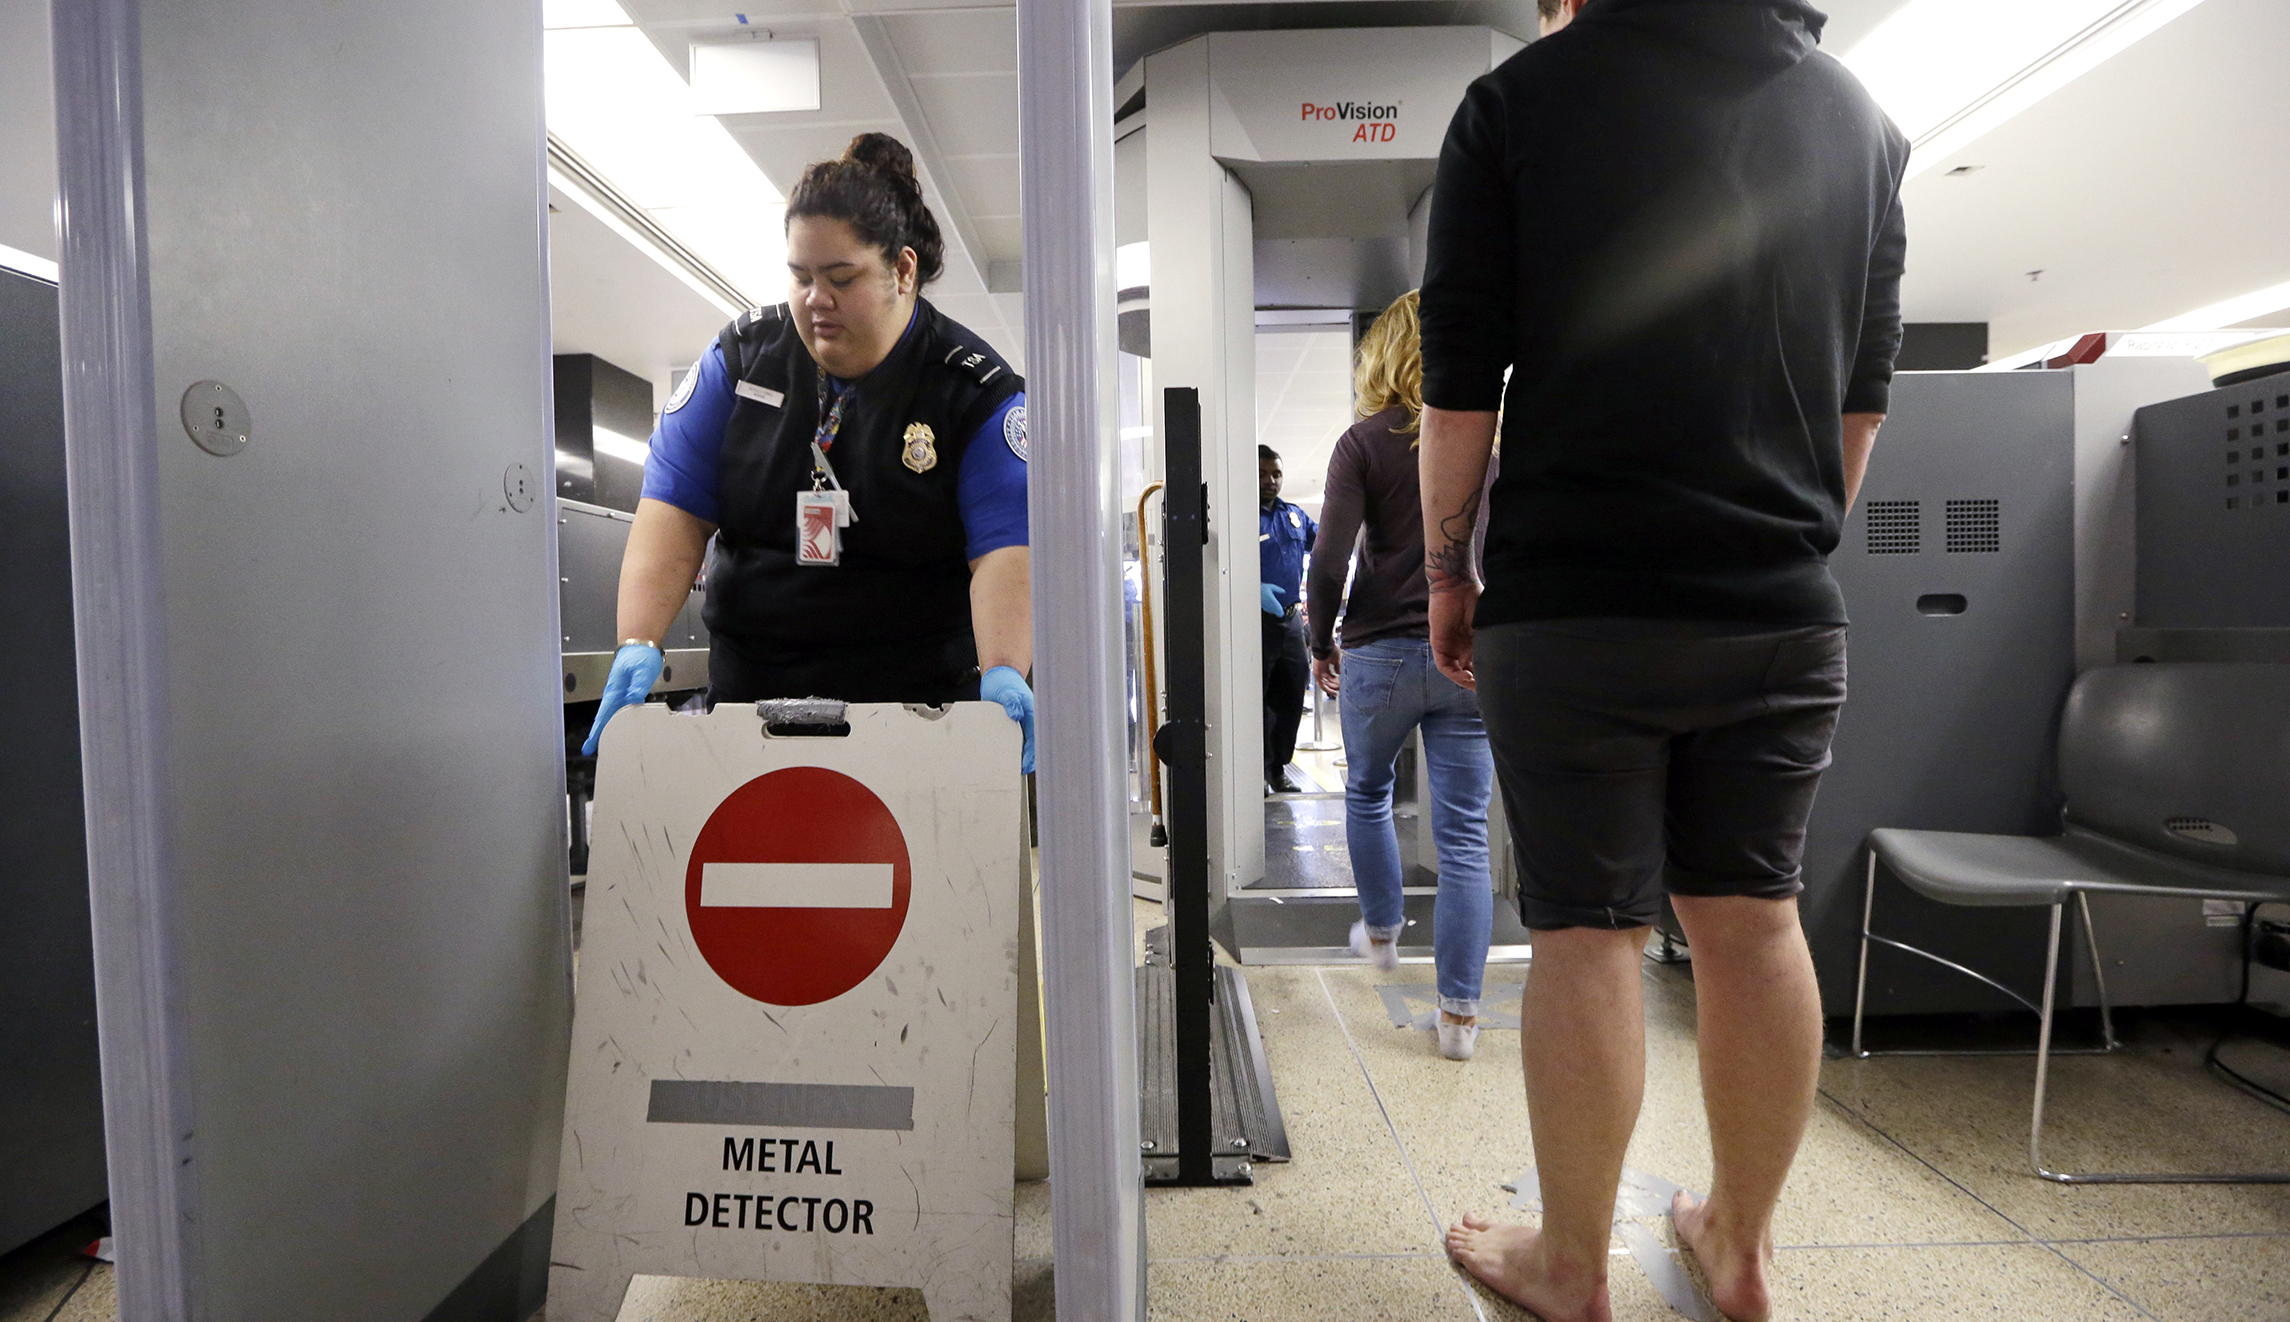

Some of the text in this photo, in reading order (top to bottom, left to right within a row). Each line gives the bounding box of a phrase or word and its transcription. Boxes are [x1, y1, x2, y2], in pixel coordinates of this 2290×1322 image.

[1302, 101, 1398, 121] ProVision
[1352, 123, 1396, 142] ATD
[961, 352, 986, 368] TSA
[722, 1137, 842, 1175] METAL
[684, 1192, 874, 1235] DETECTOR
